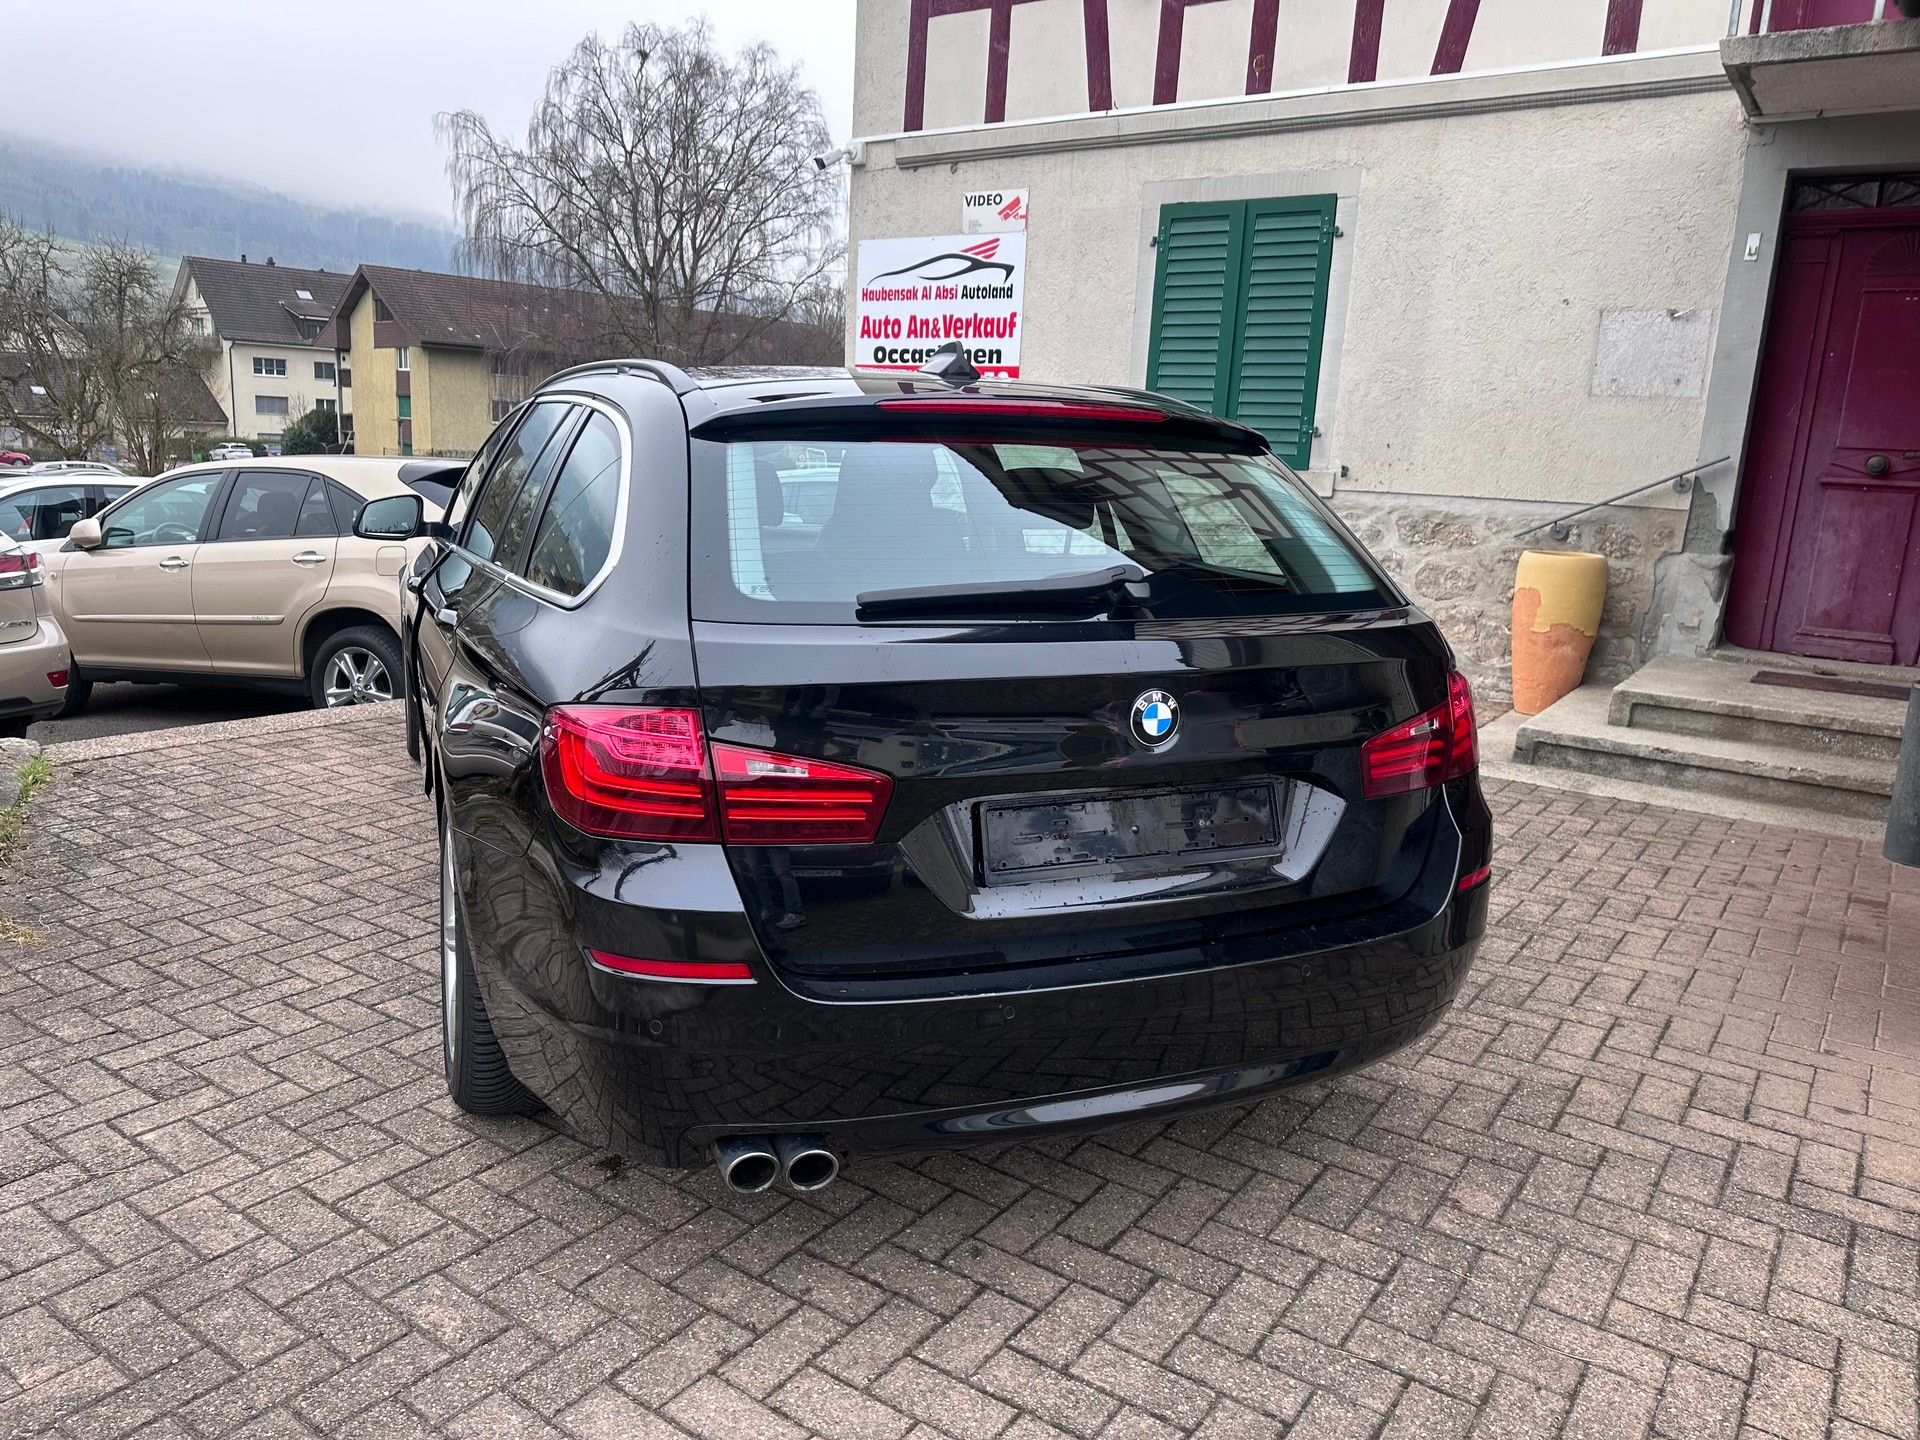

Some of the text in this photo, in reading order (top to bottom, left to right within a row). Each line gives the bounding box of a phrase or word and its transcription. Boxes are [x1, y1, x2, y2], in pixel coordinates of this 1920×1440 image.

[965, 193, 1003, 207] VIDEO
[861, 283, 1014, 302] Haubensak Al Absi Autoland
[860, 311, 1018, 339] Auto An&Verkauf
[1137, 692, 1177, 711] BMW
